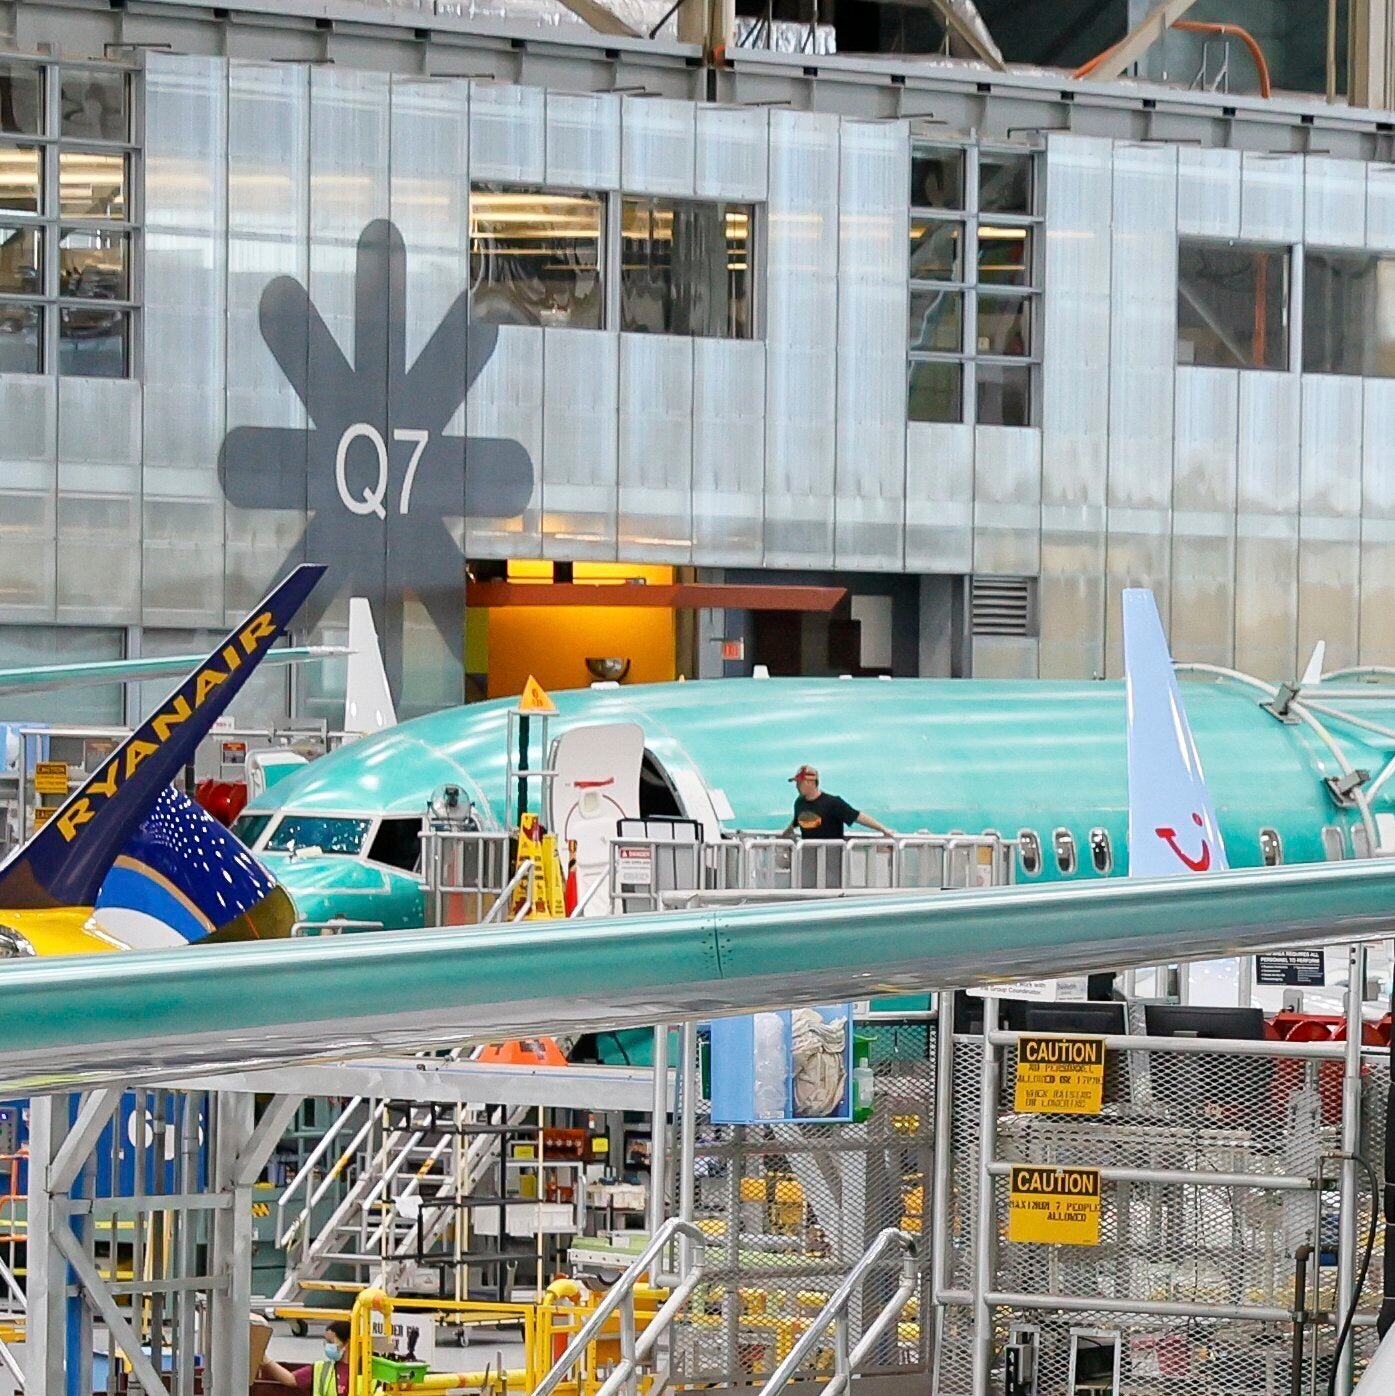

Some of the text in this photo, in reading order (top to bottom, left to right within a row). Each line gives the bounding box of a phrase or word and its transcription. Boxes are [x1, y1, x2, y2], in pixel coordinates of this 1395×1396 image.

[335, 423, 430, 520] Q7
[56, 611, 277, 842] RYANAIR
[1026, 1041, 1097, 1062] CAUTION
[1017, 1171, 1094, 1194] CAUTION
